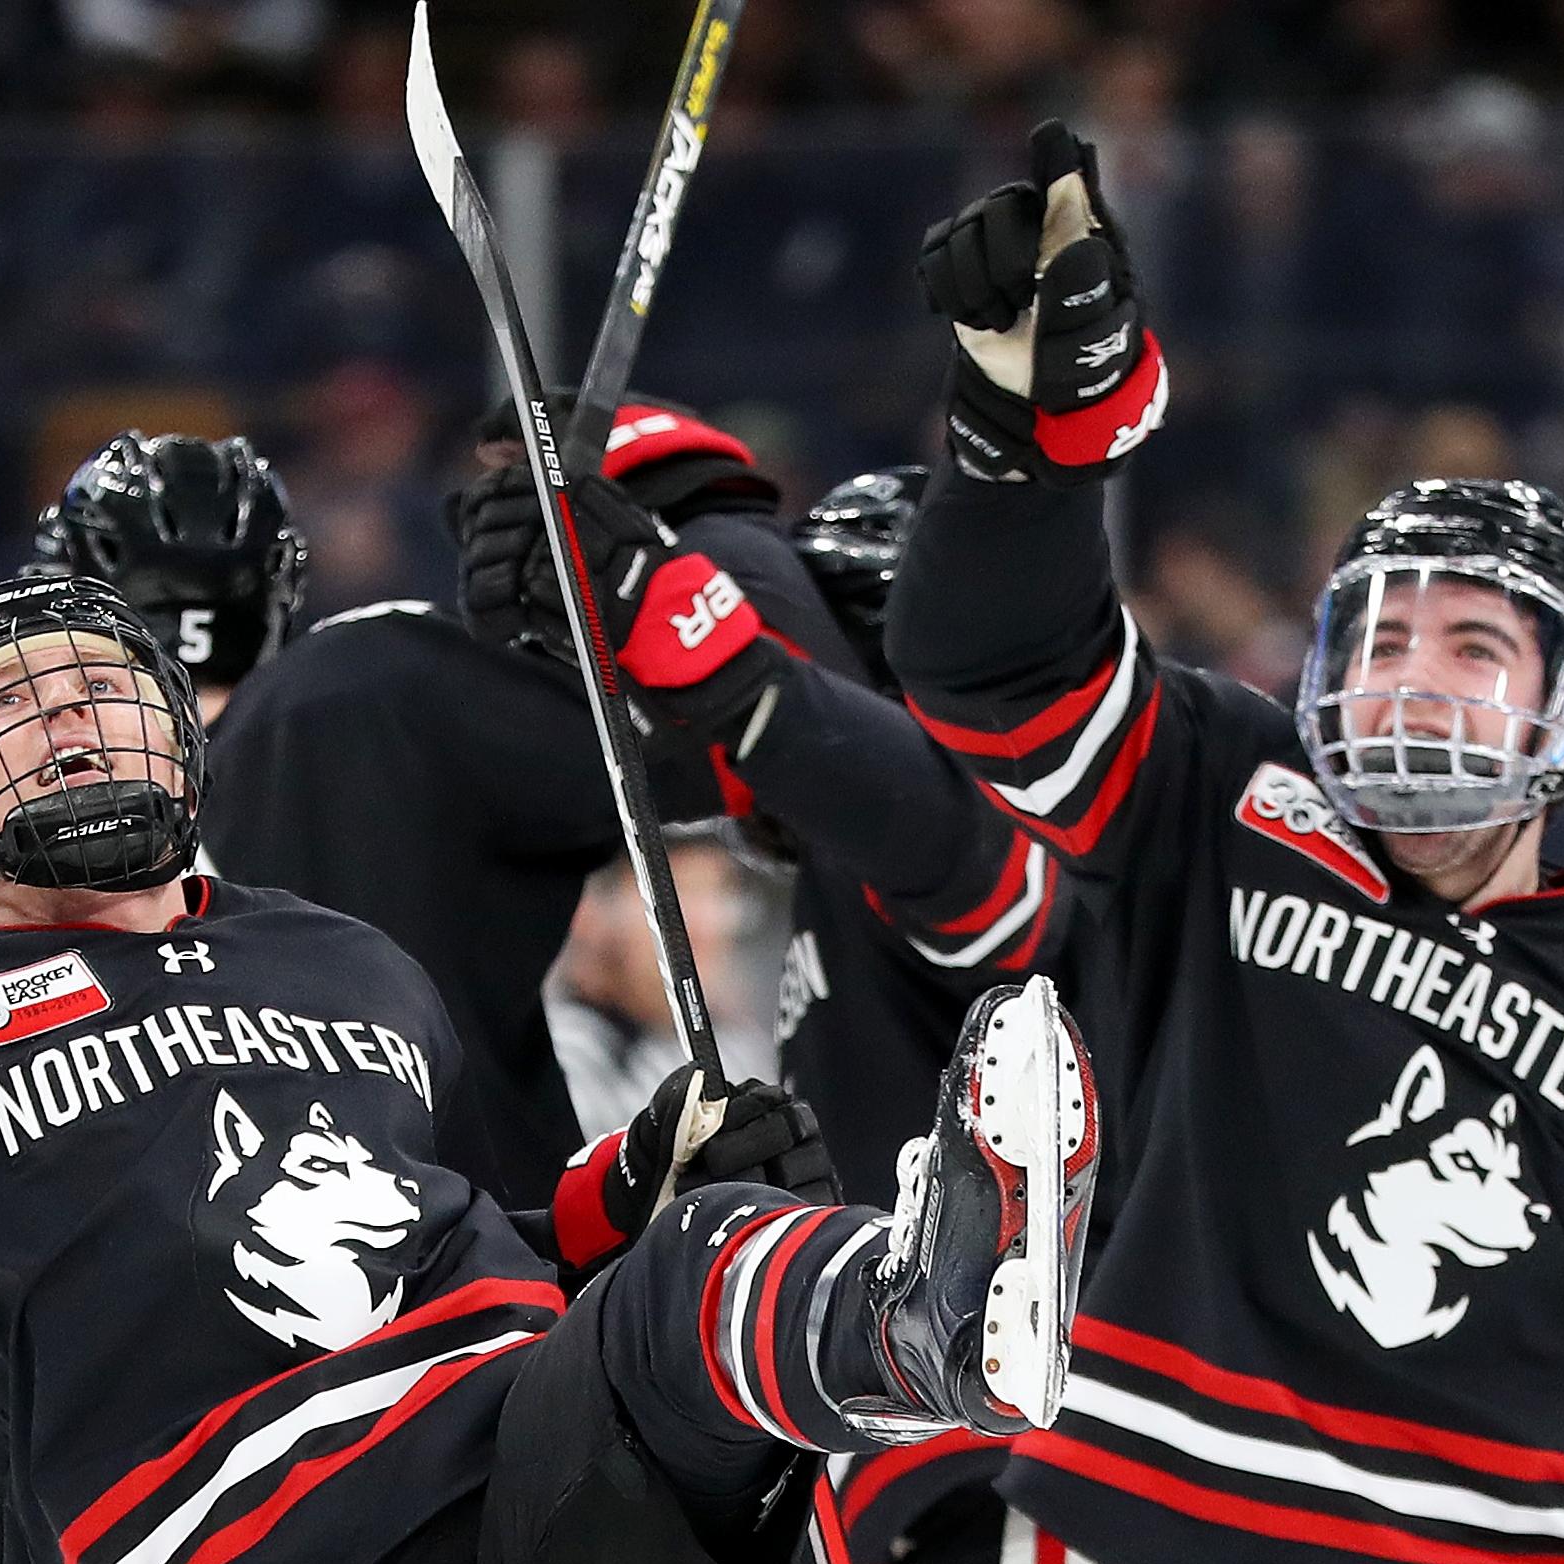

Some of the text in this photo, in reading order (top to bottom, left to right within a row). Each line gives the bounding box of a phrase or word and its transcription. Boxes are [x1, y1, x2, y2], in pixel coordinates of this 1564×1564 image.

[530, 400, 565, 488] BAUER
[177, 607, 216, 664] 5
[1, 962, 75, 996] HOCKEY
[7, 982, 51, 1006] EAST
